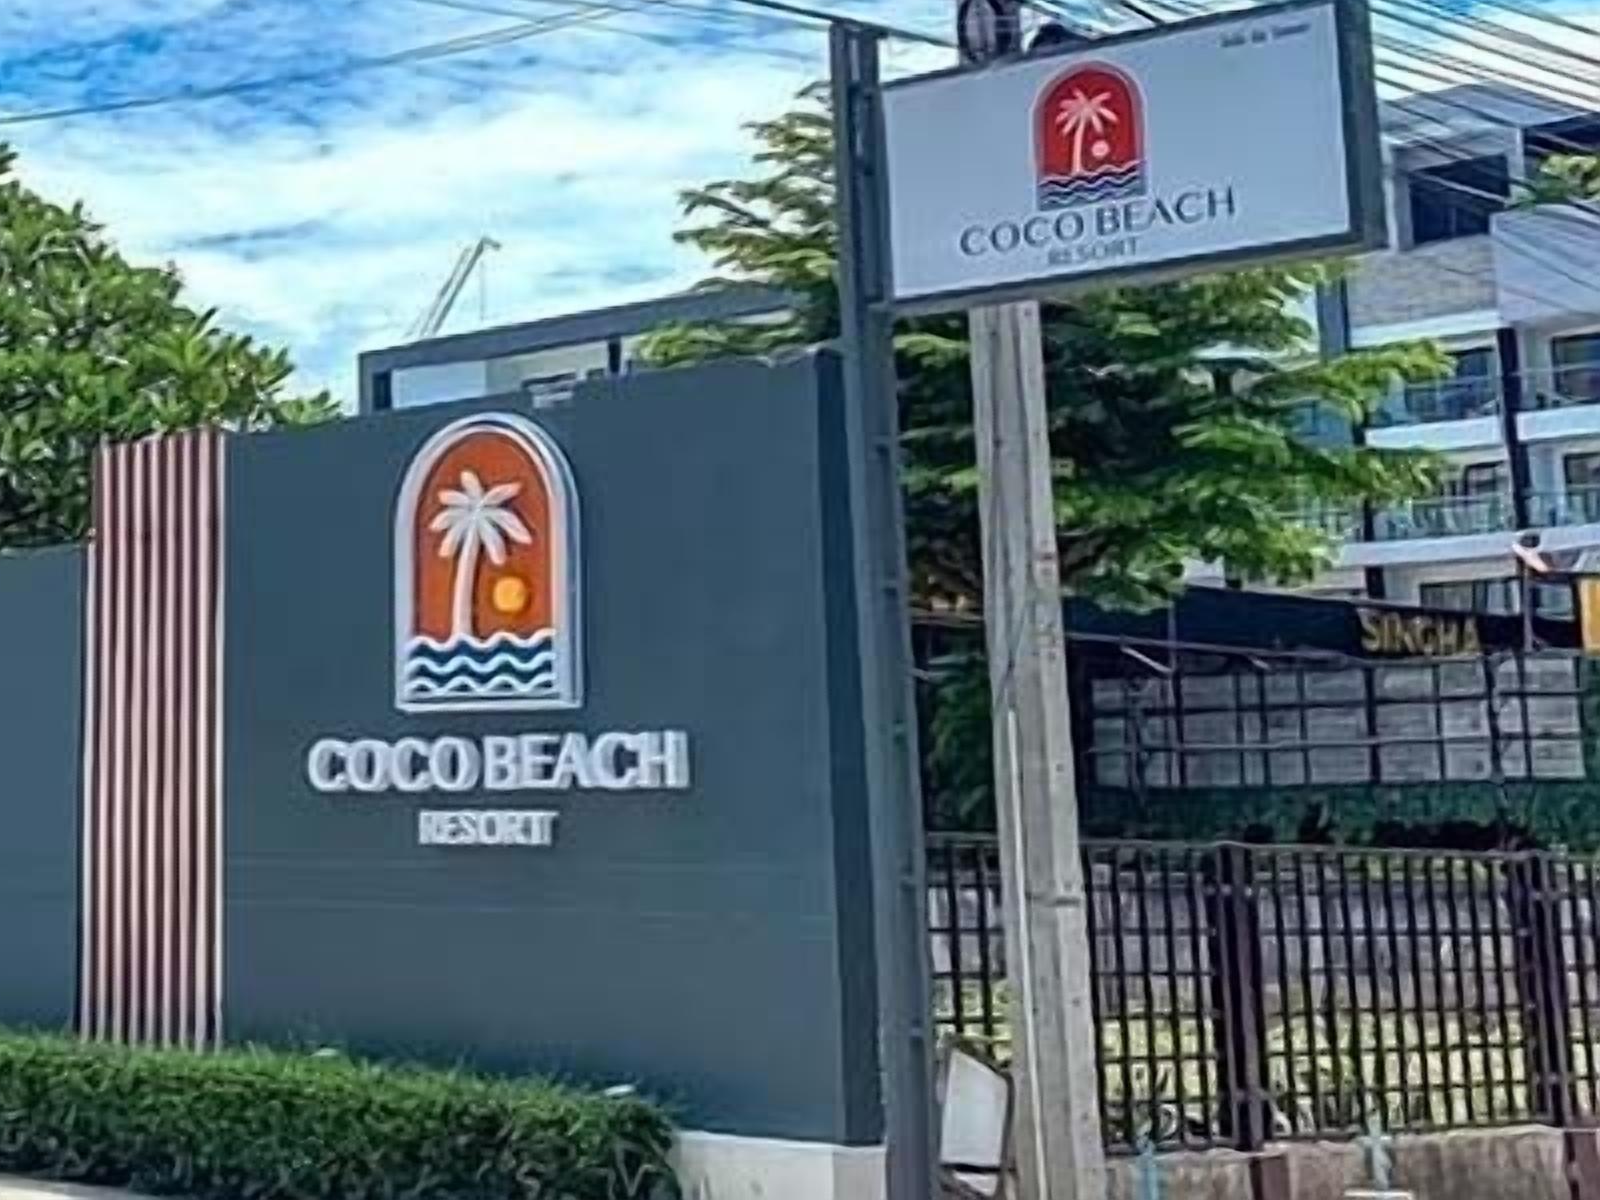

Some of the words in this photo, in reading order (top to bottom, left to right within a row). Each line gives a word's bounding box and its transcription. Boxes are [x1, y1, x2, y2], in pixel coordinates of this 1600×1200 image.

[960, 210, 1085, 256] COCO
[1095, 186, 1235, 236] BEACH
[1048, 239, 1140, 265] RESORT
[307, 736, 479, 793] COCO
[483, 730, 690, 790] BEACH
[417, 809, 559, 845] RESORT
